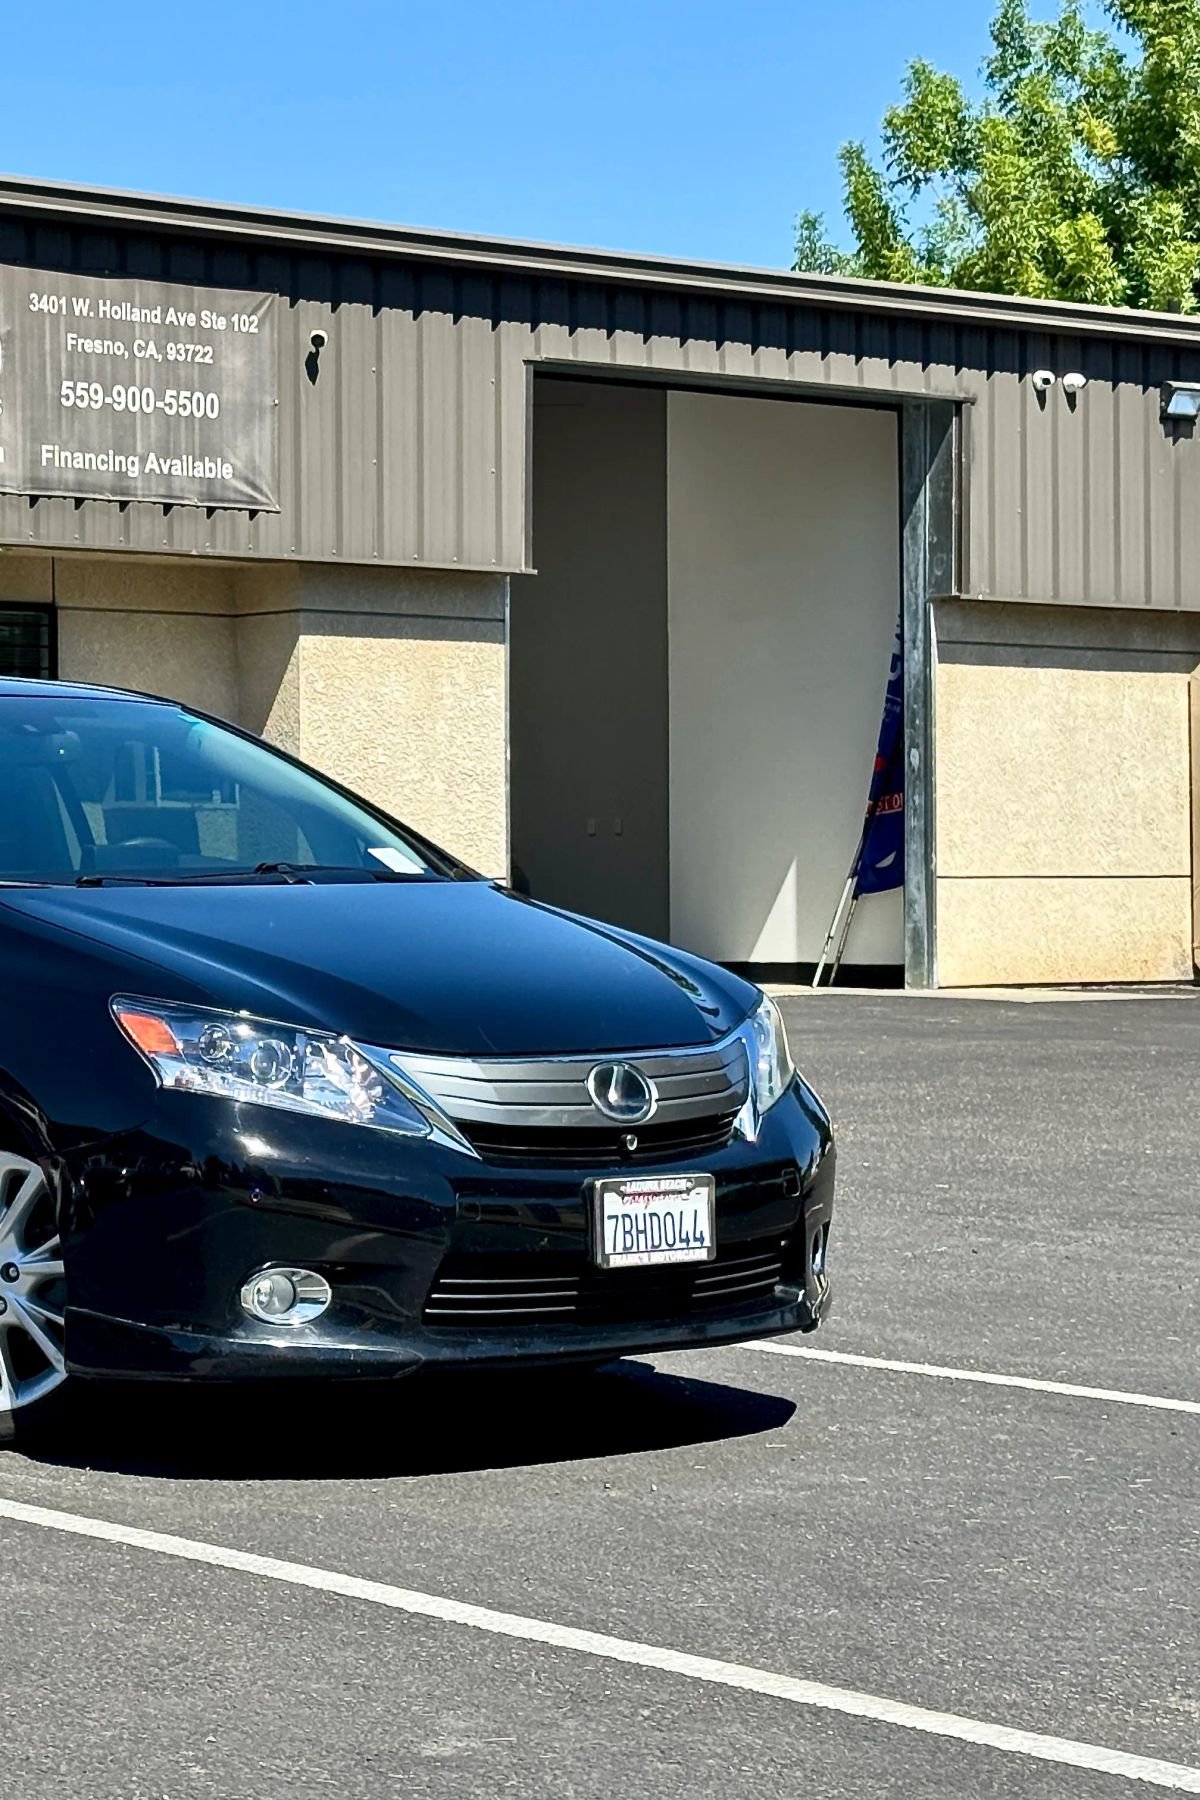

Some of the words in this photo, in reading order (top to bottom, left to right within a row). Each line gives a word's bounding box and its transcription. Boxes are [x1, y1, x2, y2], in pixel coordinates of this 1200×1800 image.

[28, 292, 67, 315] 3401
[72, 297, 94, 318] W.
[99, 299, 161, 325] Holland
[165, 307, 197, 327] Ave
[200, 310, 226, 331] Ste
[231, 313, 259, 334] 102
[66, 332, 129, 359] Fresno,
[133, 339, 163, 362] CA,
[166, 342, 214, 364] 93722
[60, 380, 220, 419] 559-900-5500
[41, 444, 140, 477] Financing
[144, 452, 234, 480] Available
[606, 1209, 705, 1252] 7BHD044
